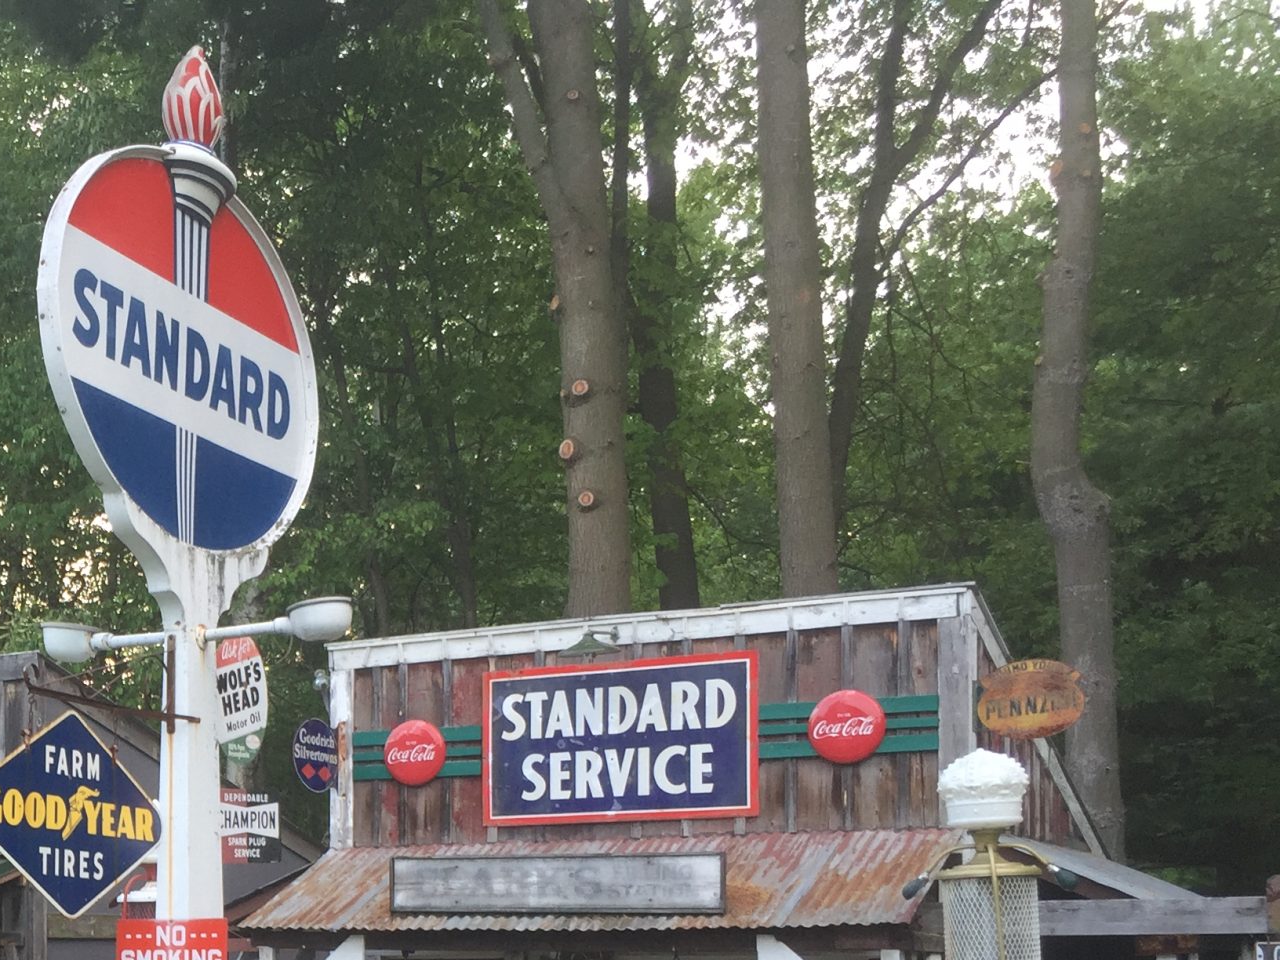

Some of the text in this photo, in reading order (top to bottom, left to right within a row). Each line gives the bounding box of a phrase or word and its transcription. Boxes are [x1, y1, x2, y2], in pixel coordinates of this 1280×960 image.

[73, 267, 291, 441] STANDARD
[222, 640, 251, 660] Ask for
[216, 661, 261, 694] WOLF'S
[222, 687, 260, 717] HEAD
[501, 678, 737, 741] STANDARD
[226, 711, 261, 732] Motor Oil
[813, 716, 874, 739] Coca-Cola
[299, 727, 335, 749] Goodrich
[45, 744, 100, 781] FARM
[294, 743, 338, 765] Silvertowns
[387, 744, 436, 765] Coca-Cola
[521, 743, 714, 801] SERVICE
[224, 793, 268, 802] DEPENDABLE
[228, 837, 266, 846] SPARK PLUG
[39, 846, 104, 880] TIRES
[234, 848, 260, 858] SERVICE
